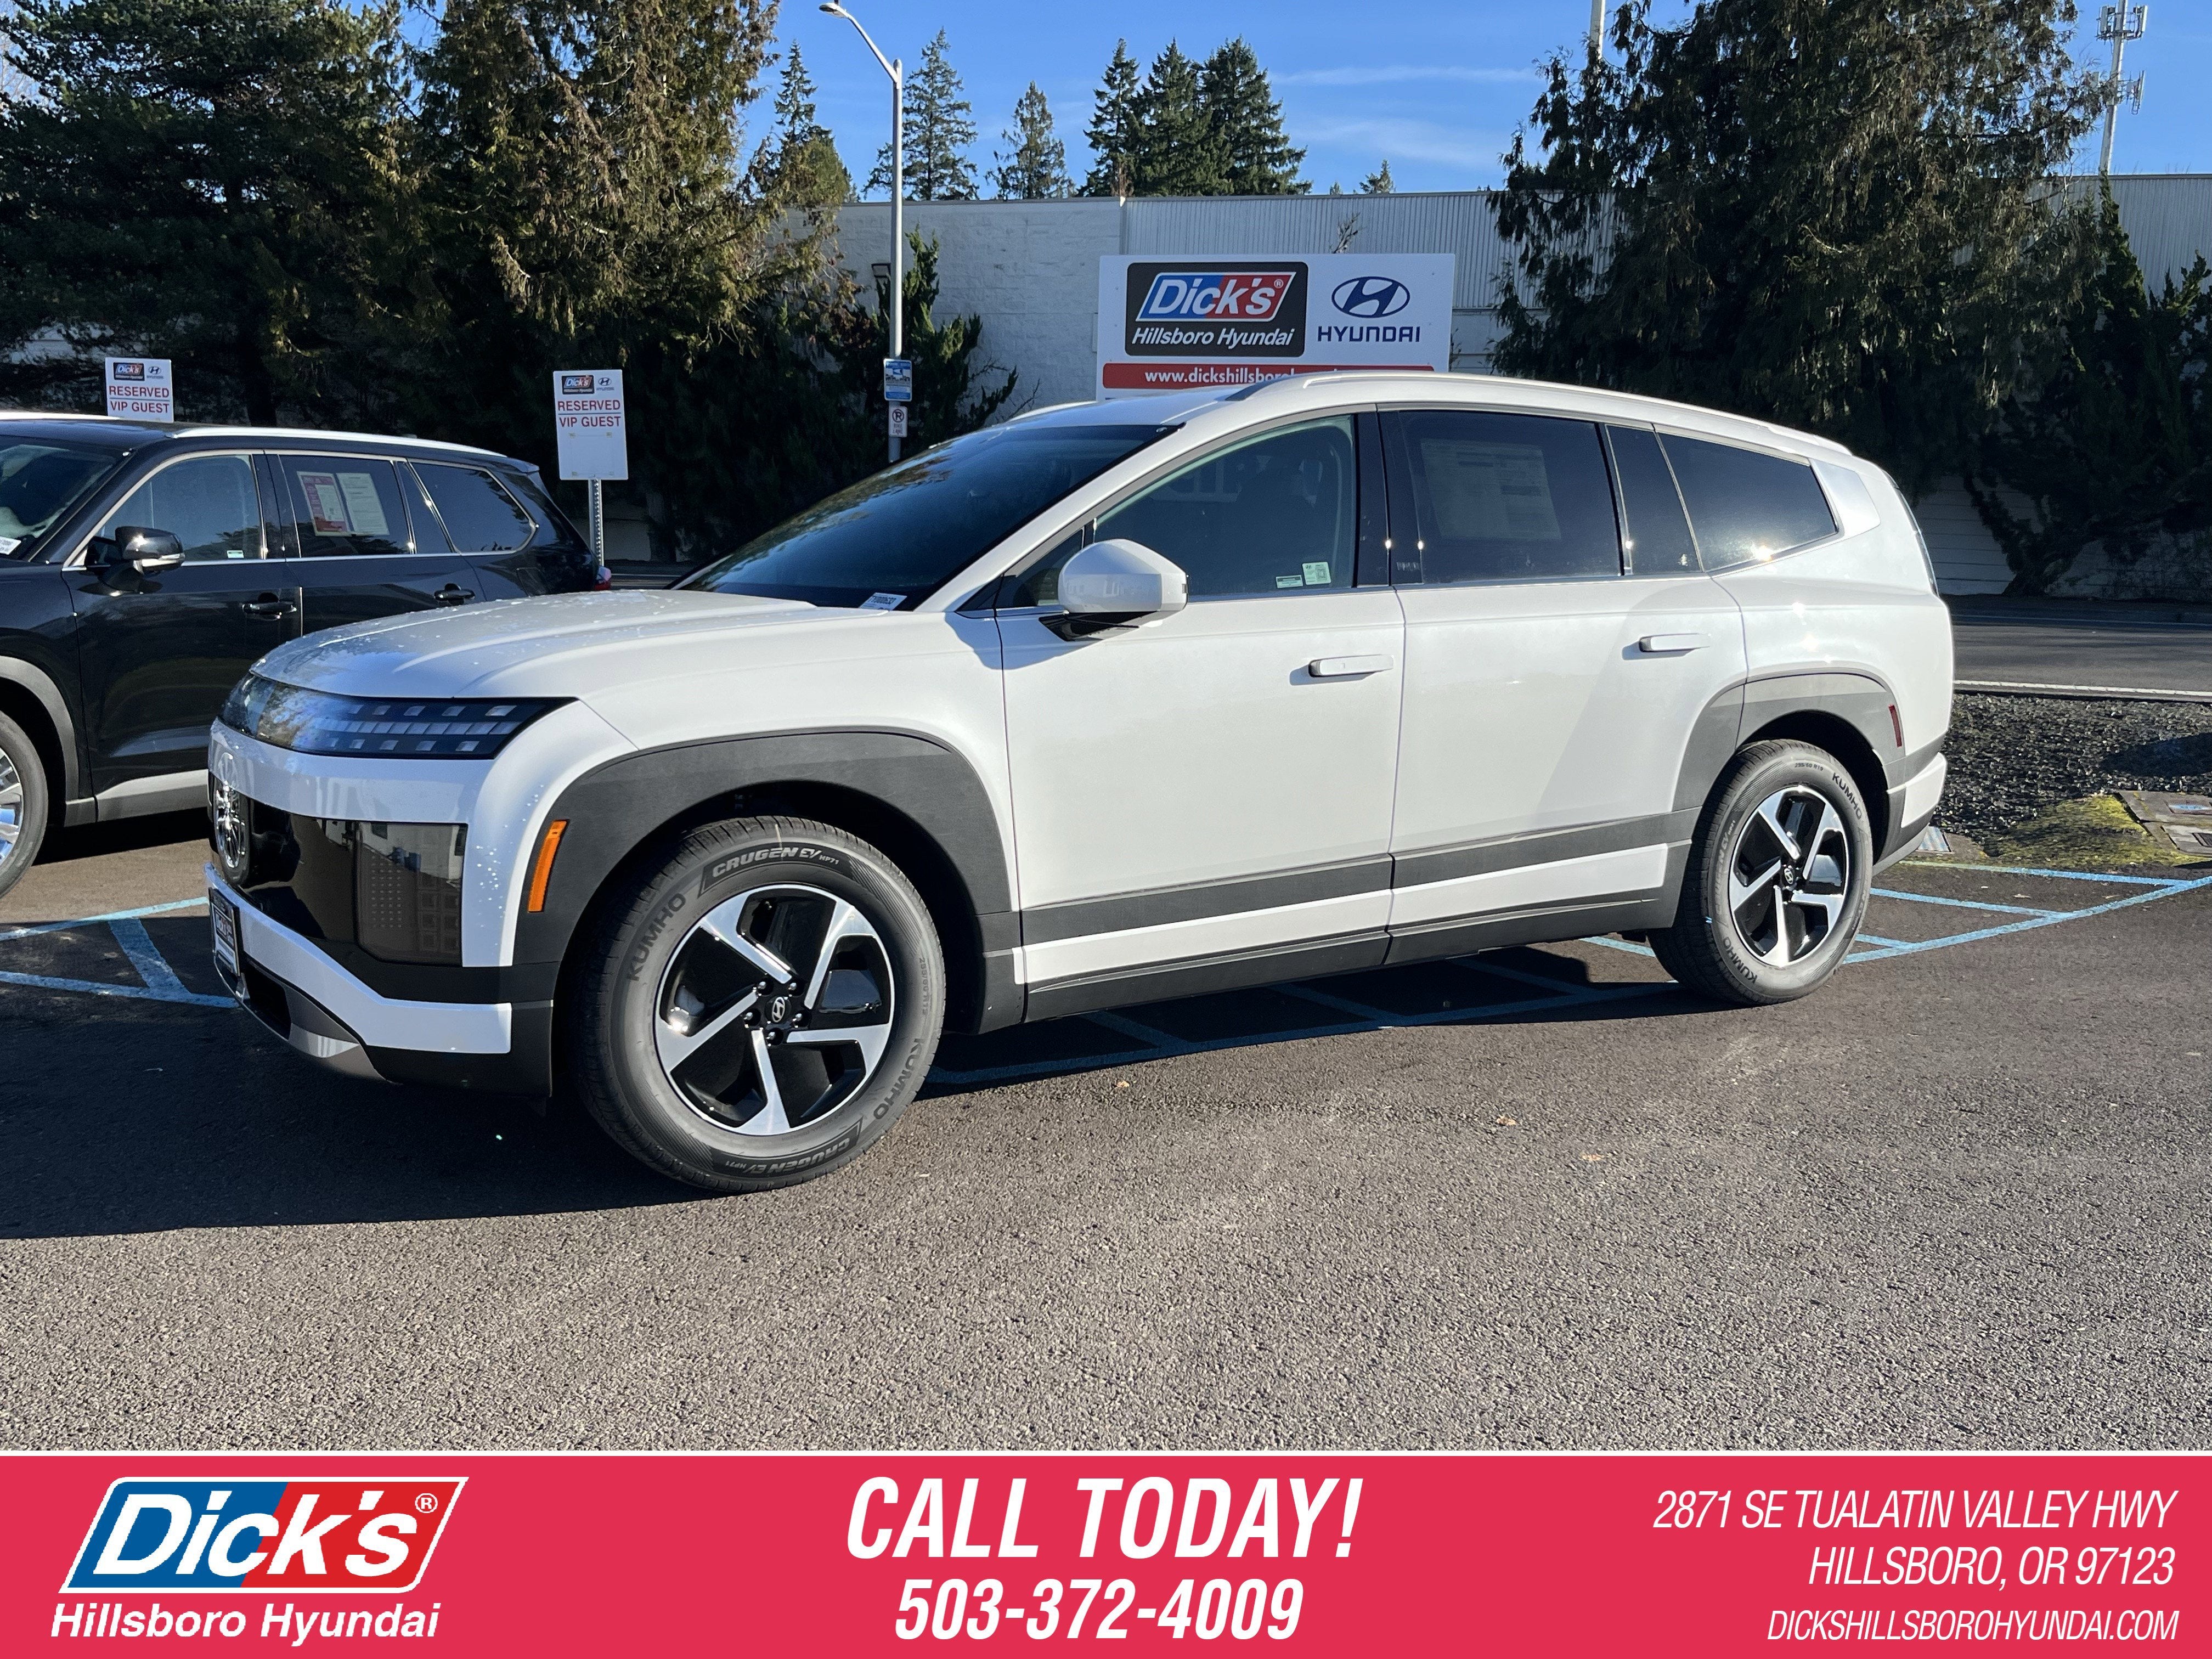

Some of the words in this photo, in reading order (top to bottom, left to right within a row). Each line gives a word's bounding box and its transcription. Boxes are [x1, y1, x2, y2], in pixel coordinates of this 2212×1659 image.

[1148, 278, 1276, 315] Dick's
[1132, 328, 1214, 345] Hillsboro
[1217, 328, 1295, 349] Hyundai
[1317, 326, 1421, 342] HYUNDAI
[109, 386, 170, 398] RESERVED
[110, 400, 128, 411] VIP
[132, 401, 170, 413] GUEST
[557, 399, 620, 411] RESERVED
[559, 417, 577, 427] VIP
[582, 416, 621, 427] GUEST
[1832, 772, 1862, 820] KUMHO
[713, 847, 799, 877] CRUGEN
[627, 893, 686, 981] KUMHO
[1723, 936, 1758, 984] KUMHO
[873, 1038, 927, 1120] KUMHO
